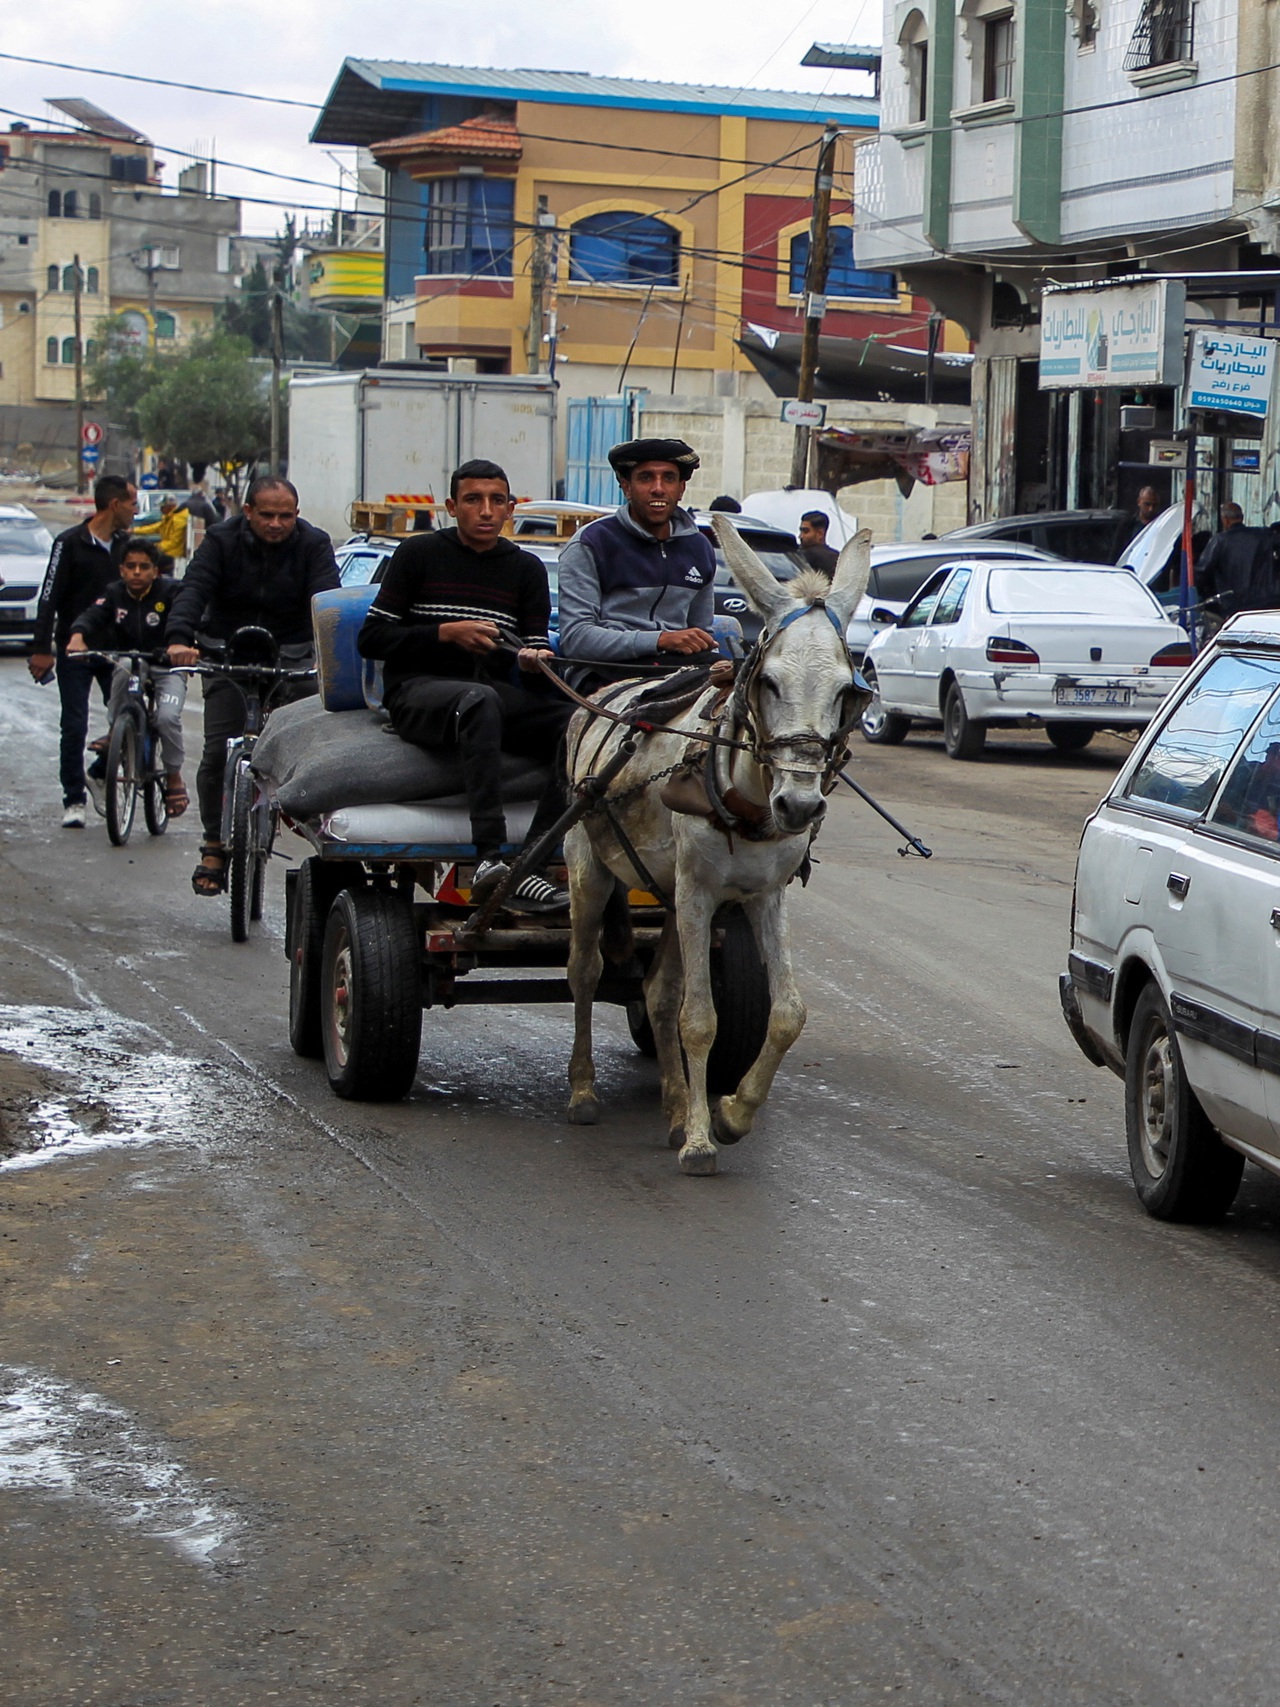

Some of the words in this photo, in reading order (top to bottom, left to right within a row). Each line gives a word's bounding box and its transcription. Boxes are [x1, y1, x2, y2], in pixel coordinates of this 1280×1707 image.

[1043, 307, 1085, 350] للبطاريات
[1112, 300, 1157, 345] اليازجي
[1200, 357, 1266, 378] للبطاريات
[1212, 380, 1230, 391] رفح
[1232, 382, 1250, 392] فرع
